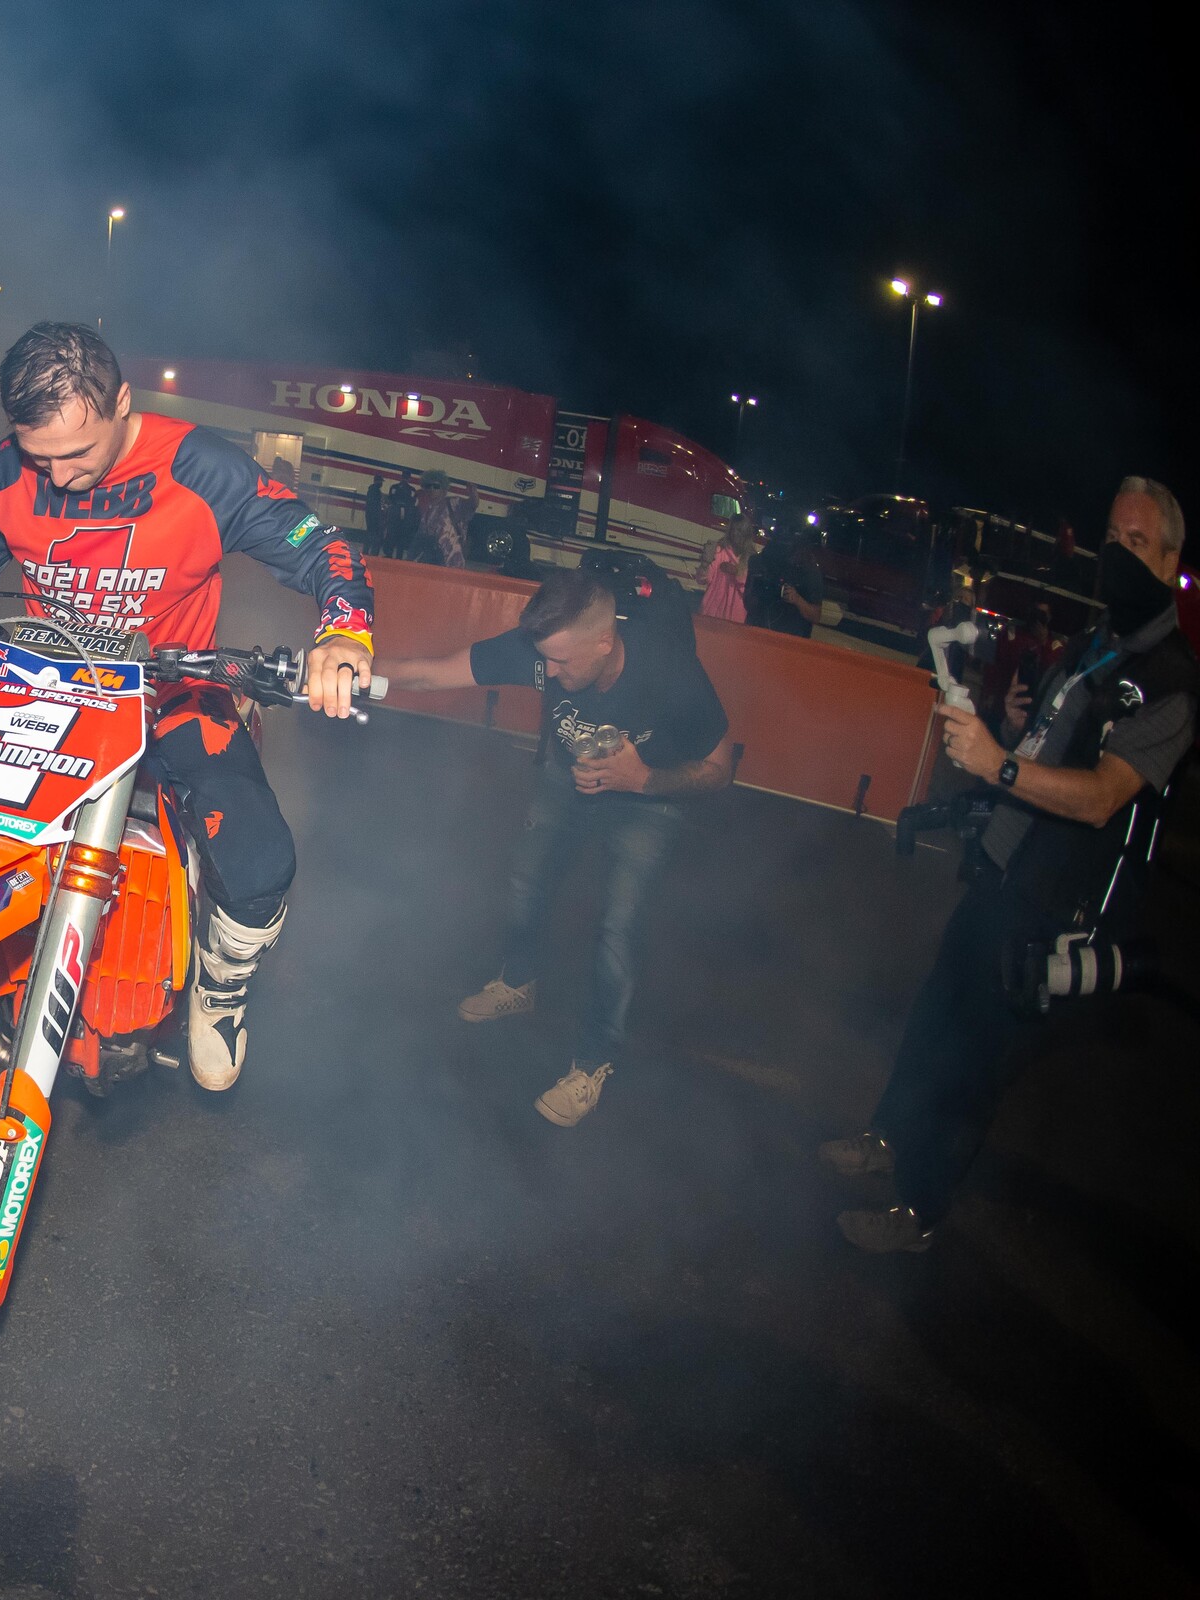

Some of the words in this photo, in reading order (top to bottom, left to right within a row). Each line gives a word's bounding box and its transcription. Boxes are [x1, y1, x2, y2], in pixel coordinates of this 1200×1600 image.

[271, 380, 491, 431] HONDA
[33, 471, 157, 520] WEBB
[22, 559, 91, 590] 2021
[95, 568, 168, 592] AMA
[100, 594, 147, 615] SX
[53, 620, 128, 640] NTHAL
[71, 668, 126, 689] KTM
[0, 683, 27, 697] AMA
[28, 687, 119, 713] SUPERCROSS
[9, 716, 60, 734] WEBB
[13, 711, 45, 721] COOPER
